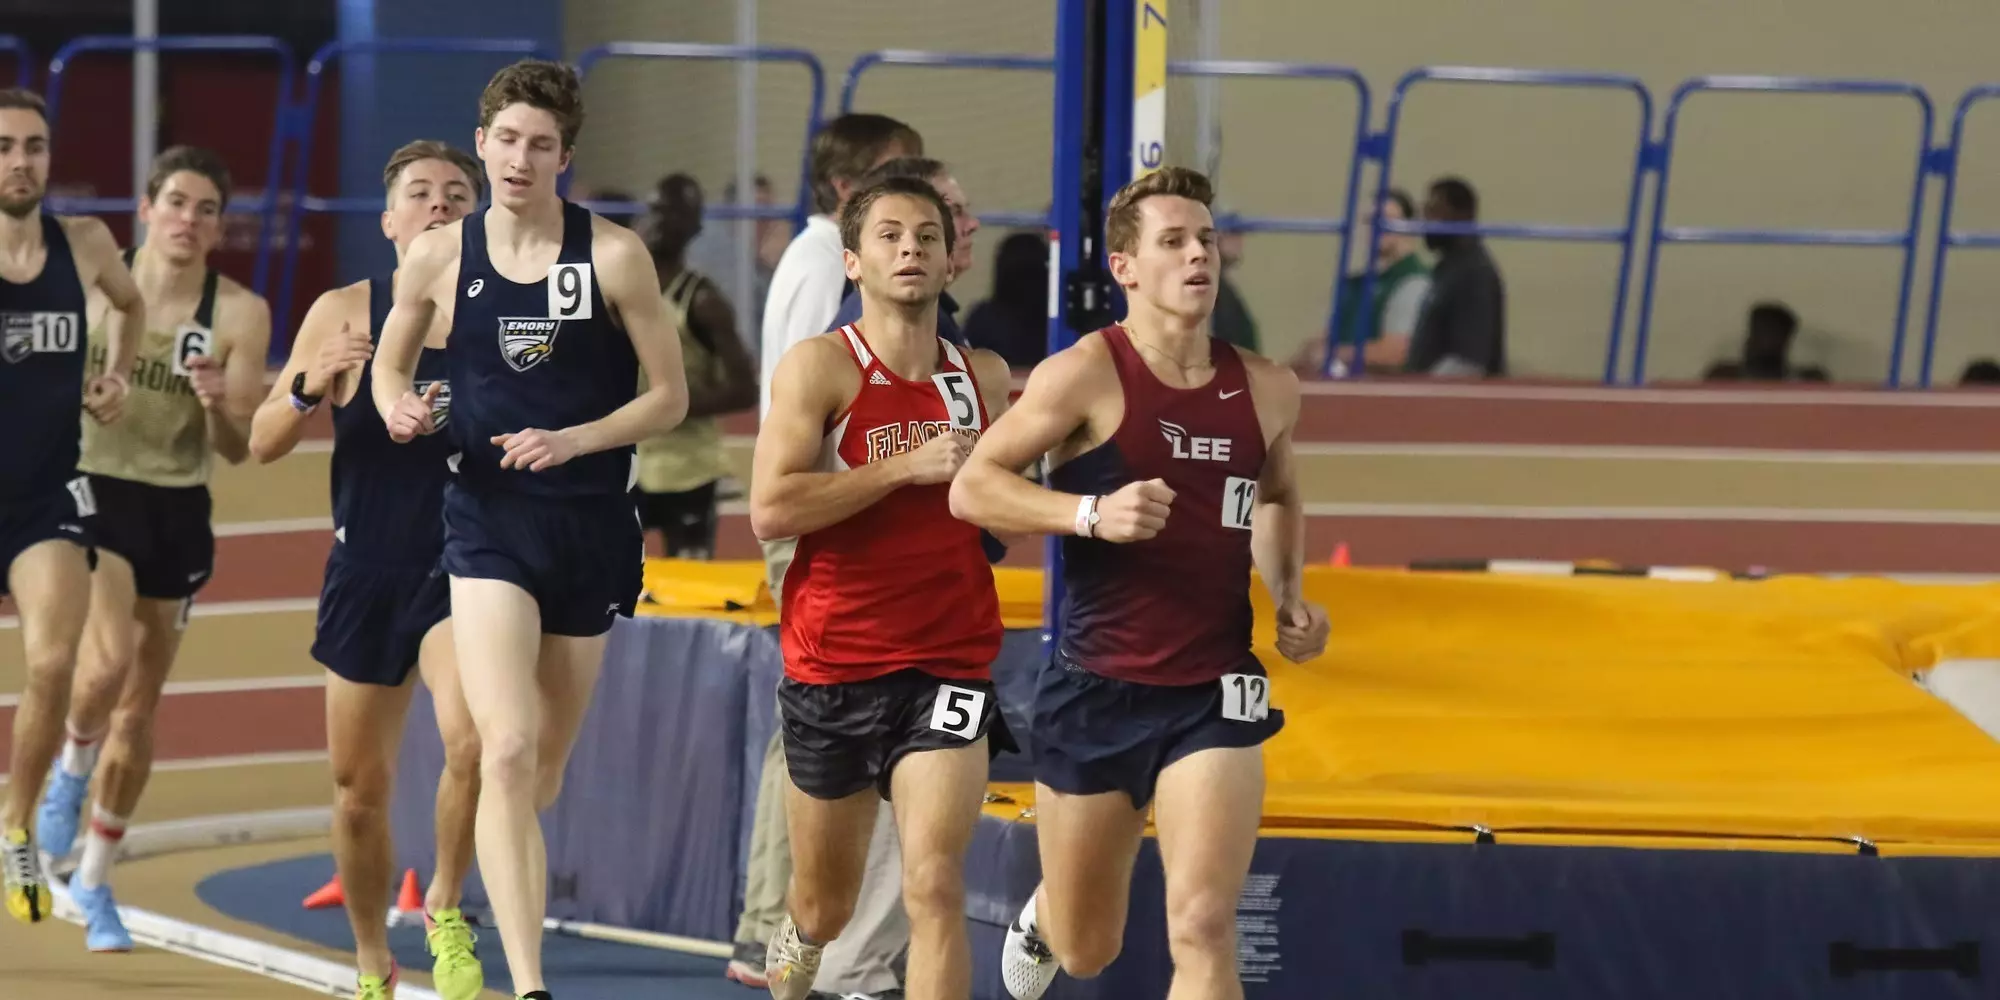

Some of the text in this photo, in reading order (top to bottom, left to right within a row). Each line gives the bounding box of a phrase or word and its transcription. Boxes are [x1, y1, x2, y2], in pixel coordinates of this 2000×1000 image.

[1143, 2, 1167, 30] 7
[557, 266, 582, 316] 9
[38, 316, 71, 349] 10
[506, 321, 556, 331] EMORY
[90, 343, 198, 398] HRDIN
[181, 332, 205, 371] 6
[943, 375, 974, 427] 5
[1172, 435, 1232, 462] LEE
[1234, 481, 1257, 527] 12
[942, 690, 974, 732] 5
[1233, 675, 1265, 720] 12
